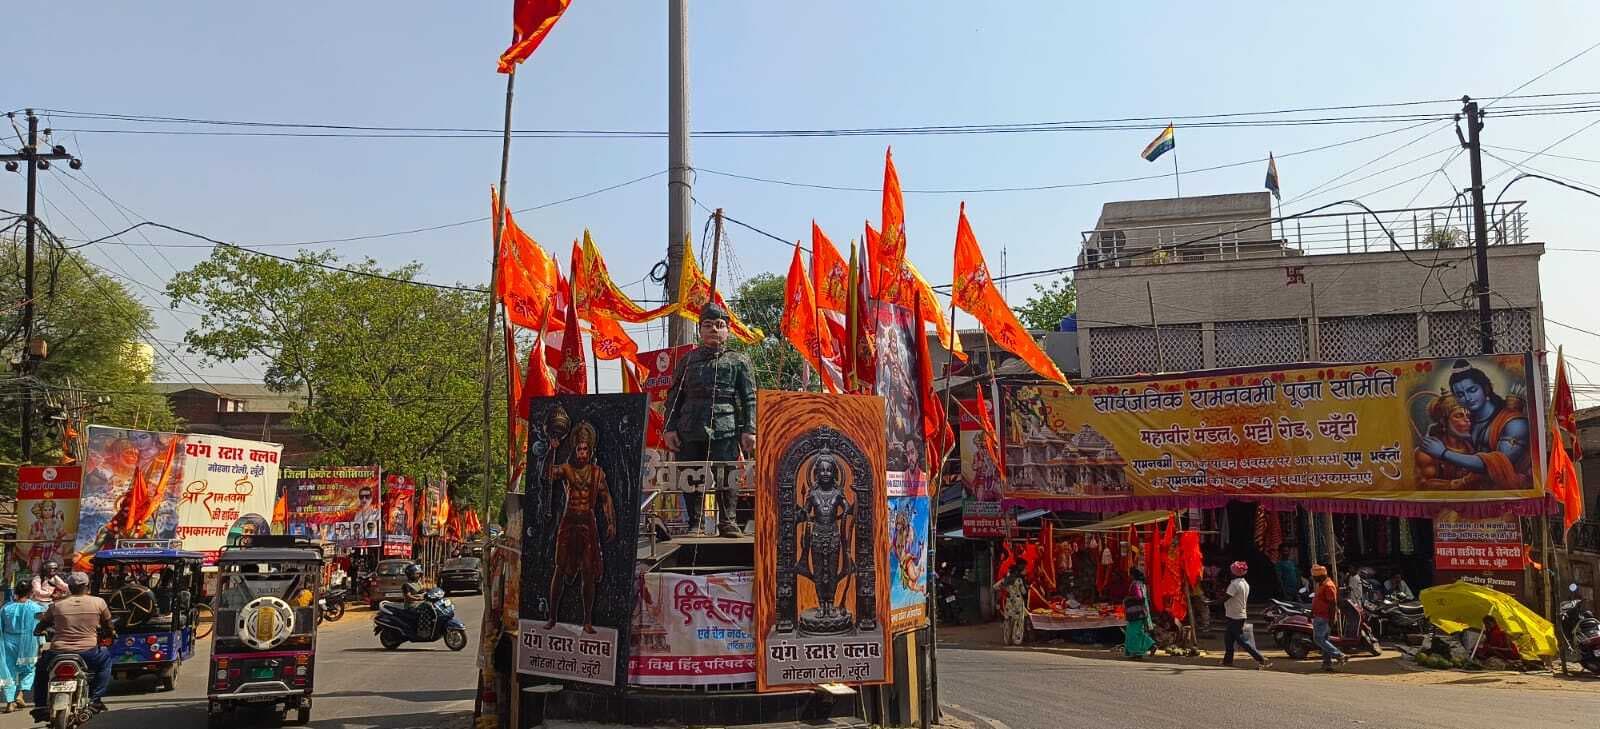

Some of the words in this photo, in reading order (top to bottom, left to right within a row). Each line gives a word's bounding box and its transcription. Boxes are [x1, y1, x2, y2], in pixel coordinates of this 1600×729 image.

[1093, 387, 1185, 413] सार्वजनिक
[1189, 377, 1276, 408] रामनवमी
[1282, 380, 1322, 409] पूजा
[1330, 369, 1398, 399] समिति
[1140, 423, 1190, 448] महावीर
[1194, 422, 1239, 446] मंडल,
[1244, 417, 1273, 444] भट्टी
[1278, 415, 1313, 440] रोड,
[1318, 412, 1359, 442] खूँटी
[186, 440, 211, 459] यंग
[218, 446, 244, 461] स्टार
[249, 449, 278, 464] क्लब
[717, 598, 754, 621] नवव
[523, 630, 542, 648] यंग
[548, 635, 574, 652] स्टार
[578, 640, 611, 656] क्लब
[770, 641, 797, 660] यंग
[804, 644, 837, 660] स्टार
[843, 642, 880, 658] क्लब
[782, 666, 816, 680] मोहना
